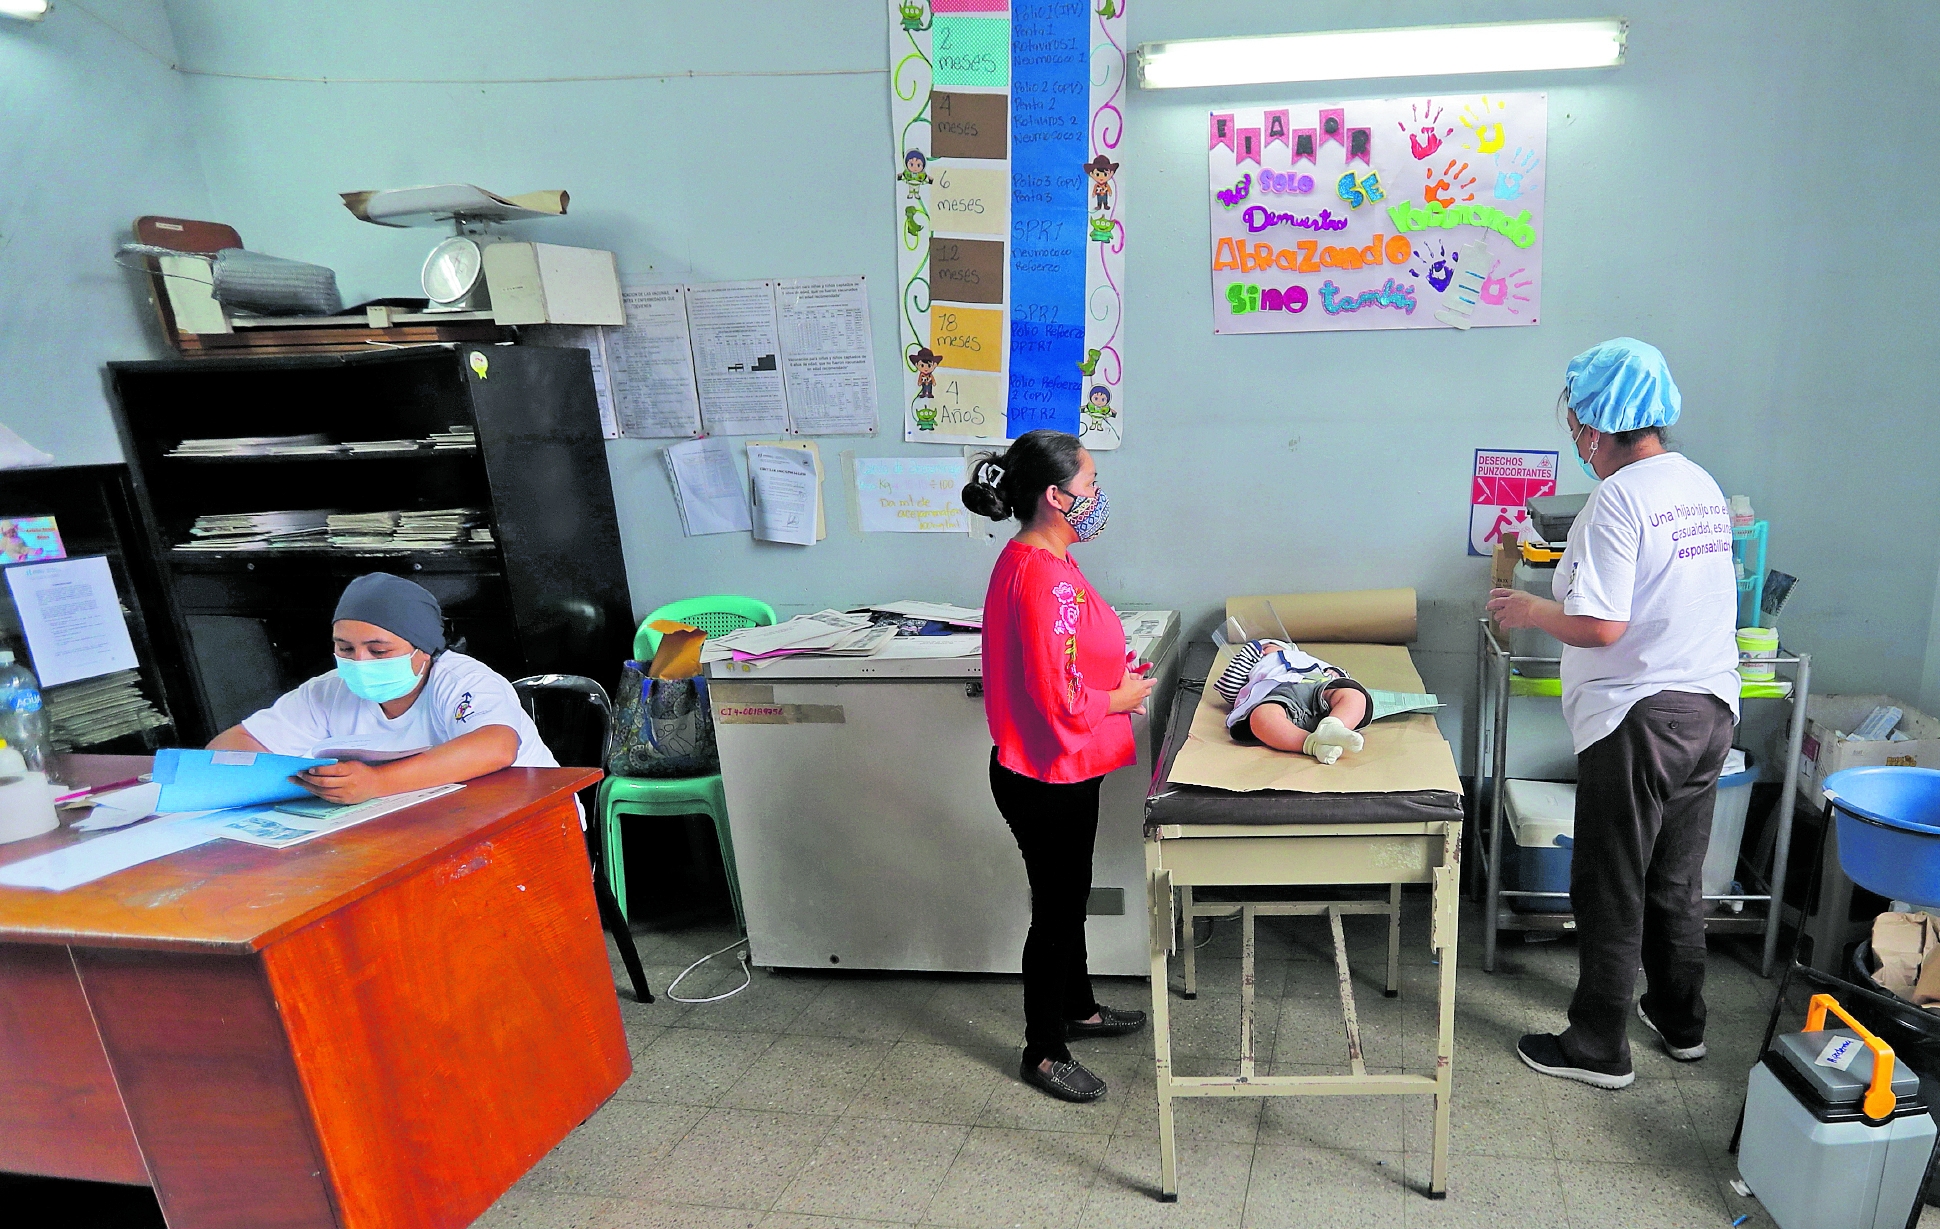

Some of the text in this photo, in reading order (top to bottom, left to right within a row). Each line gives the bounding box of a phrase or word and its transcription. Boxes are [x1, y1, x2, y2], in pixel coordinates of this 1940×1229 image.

[940, 27, 952, 50] 2
[939, 54, 996, 72] meses
[1014, 81, 1038, 94] Polio
[1042, 81, 1048, 93] 2
[939, 95, 950, 116] 4
[1014, 97, 1056, 111] Penta 2
[938, 121, 978, 136] meses
[1069, 116, 1078, 125] 2
[939, 170, 950, 189] 6
[1013, 173, 1042, 188] Polio
[1337, 172, 1385, 208] SE
[937, 198, 985, 214] meses
[1012, 219, 1052, 241] SPR
[938, 245, 959, 262] 12
[938, 268, 980, 284] meses
[938, 313, 958, 332] 18
[1011, 322, 1085, 339] Polio Refuerzo
[936, 335, 981, 351] meses
[946, 380, 959, 404] 4
[941, 405, 985, 425] Años
[1011, 407, 1056, 420] DPT R2
[1478, 455, 1523, 466] DESECHOS
[1477, 466, 1552, 478] PUNZOCORTANTES
[939, 480, 954, 490] 100
[917, 497, 931, 508] de
[1649, 511, 1675, 527] Una
[1709, 505, 1721, 516] no
